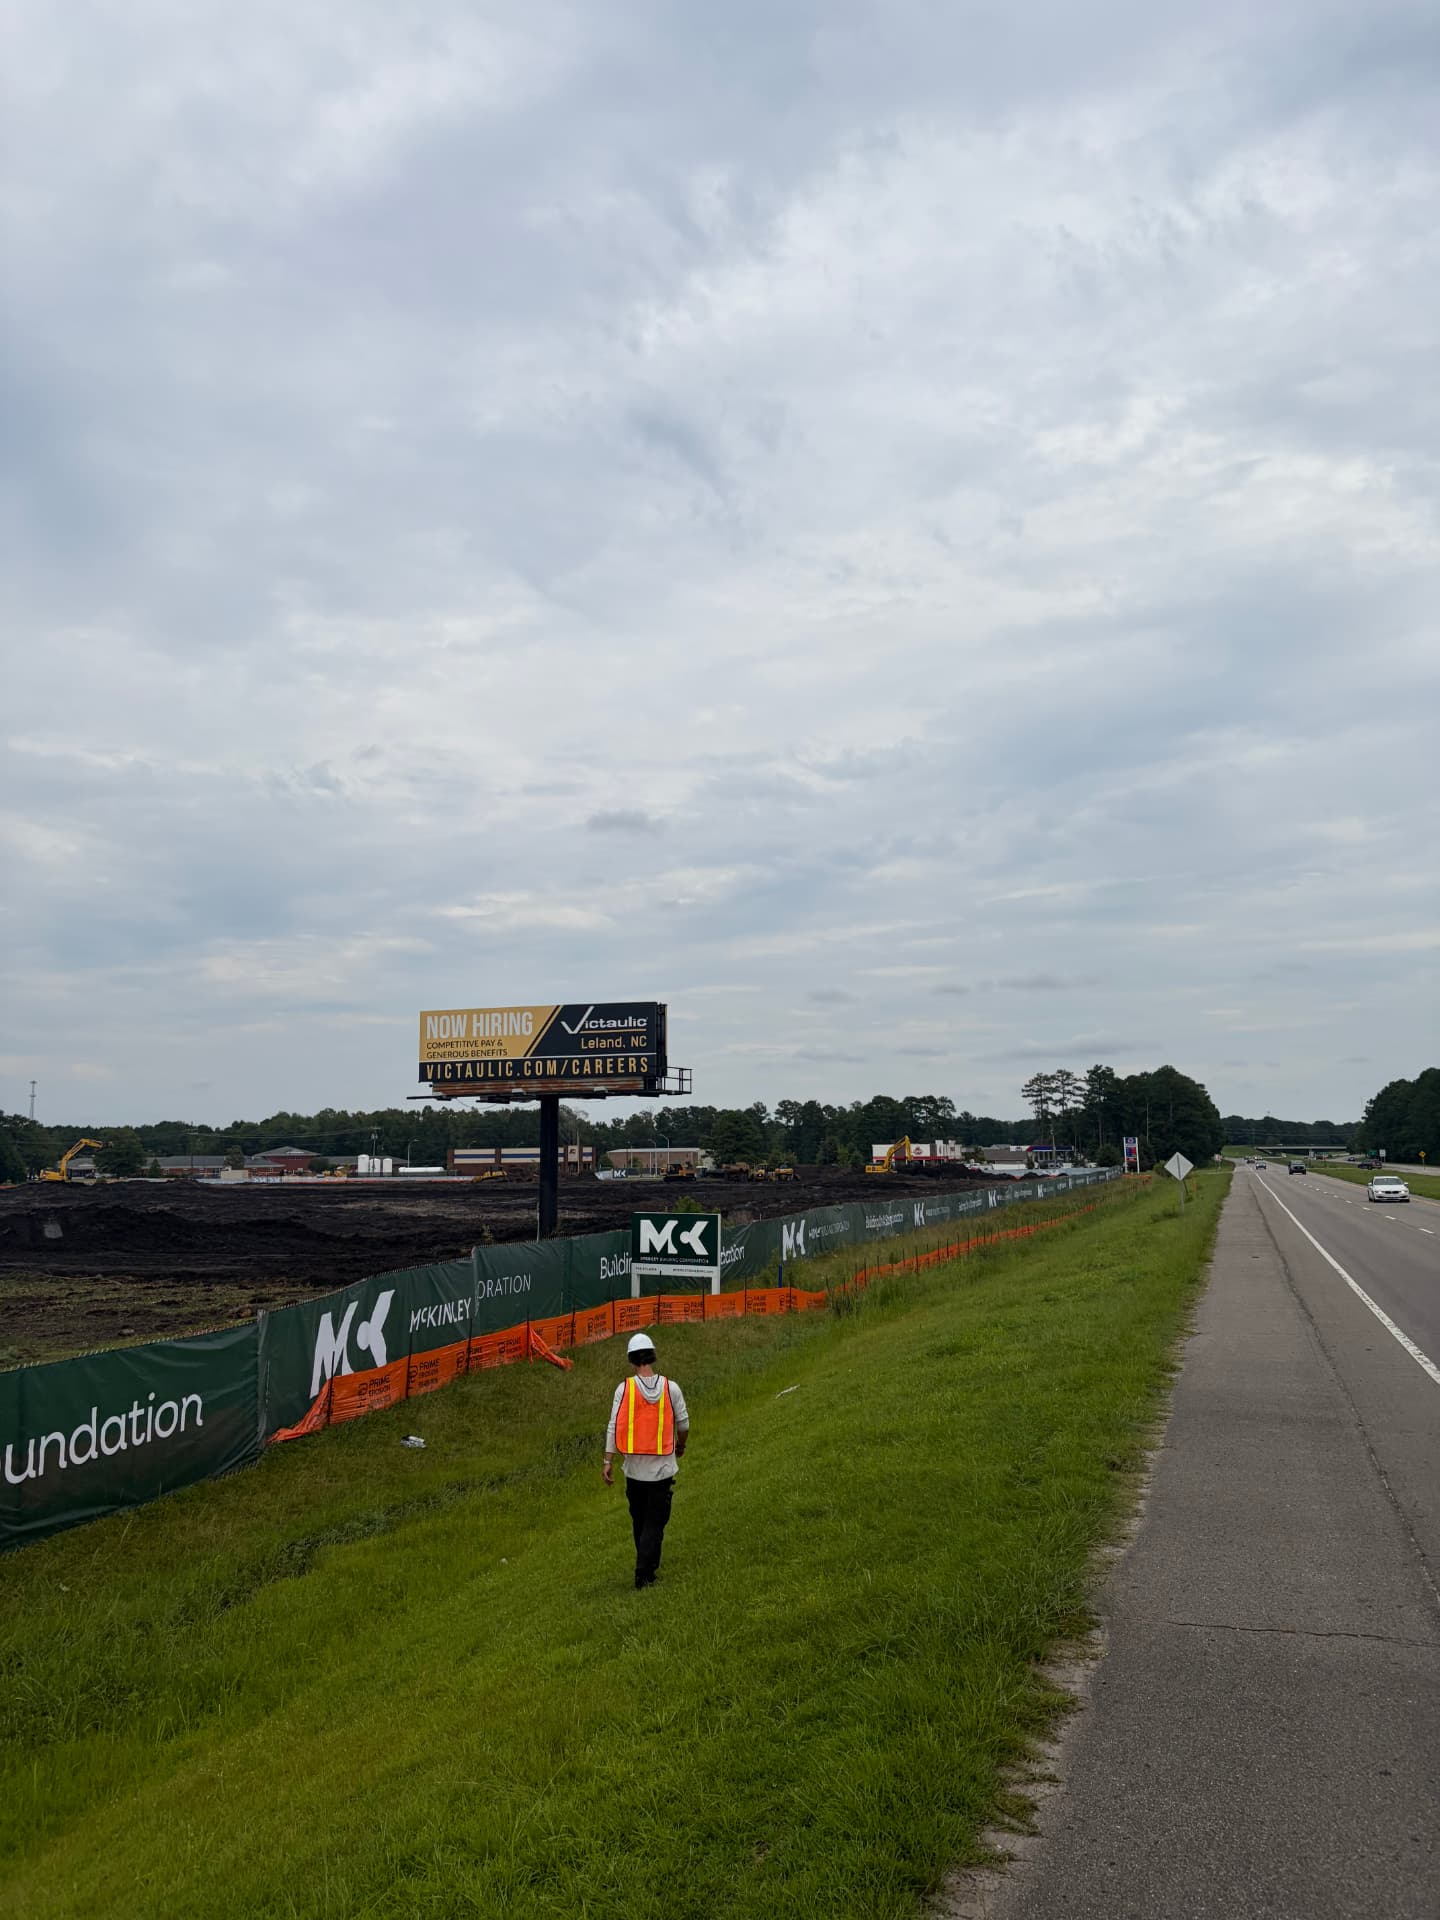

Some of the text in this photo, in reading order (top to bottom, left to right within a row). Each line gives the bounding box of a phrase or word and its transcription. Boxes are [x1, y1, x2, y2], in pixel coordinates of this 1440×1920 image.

[426, 1011, 534, 1040] NOW HIRING
[560, 1006, 647, 1034] Victaulic
[426, 1039, 503, 1050] COMPETITIVE PAY &
[426, 1048, 508, 1059] GENEROUS BENEFITS
[581, 1035, 647, 1049] Leland, NC
[426, 1056, 649, 1079] VICTAULIC.COM/CAREERS
[0, 1392, 204, 1485] undation
